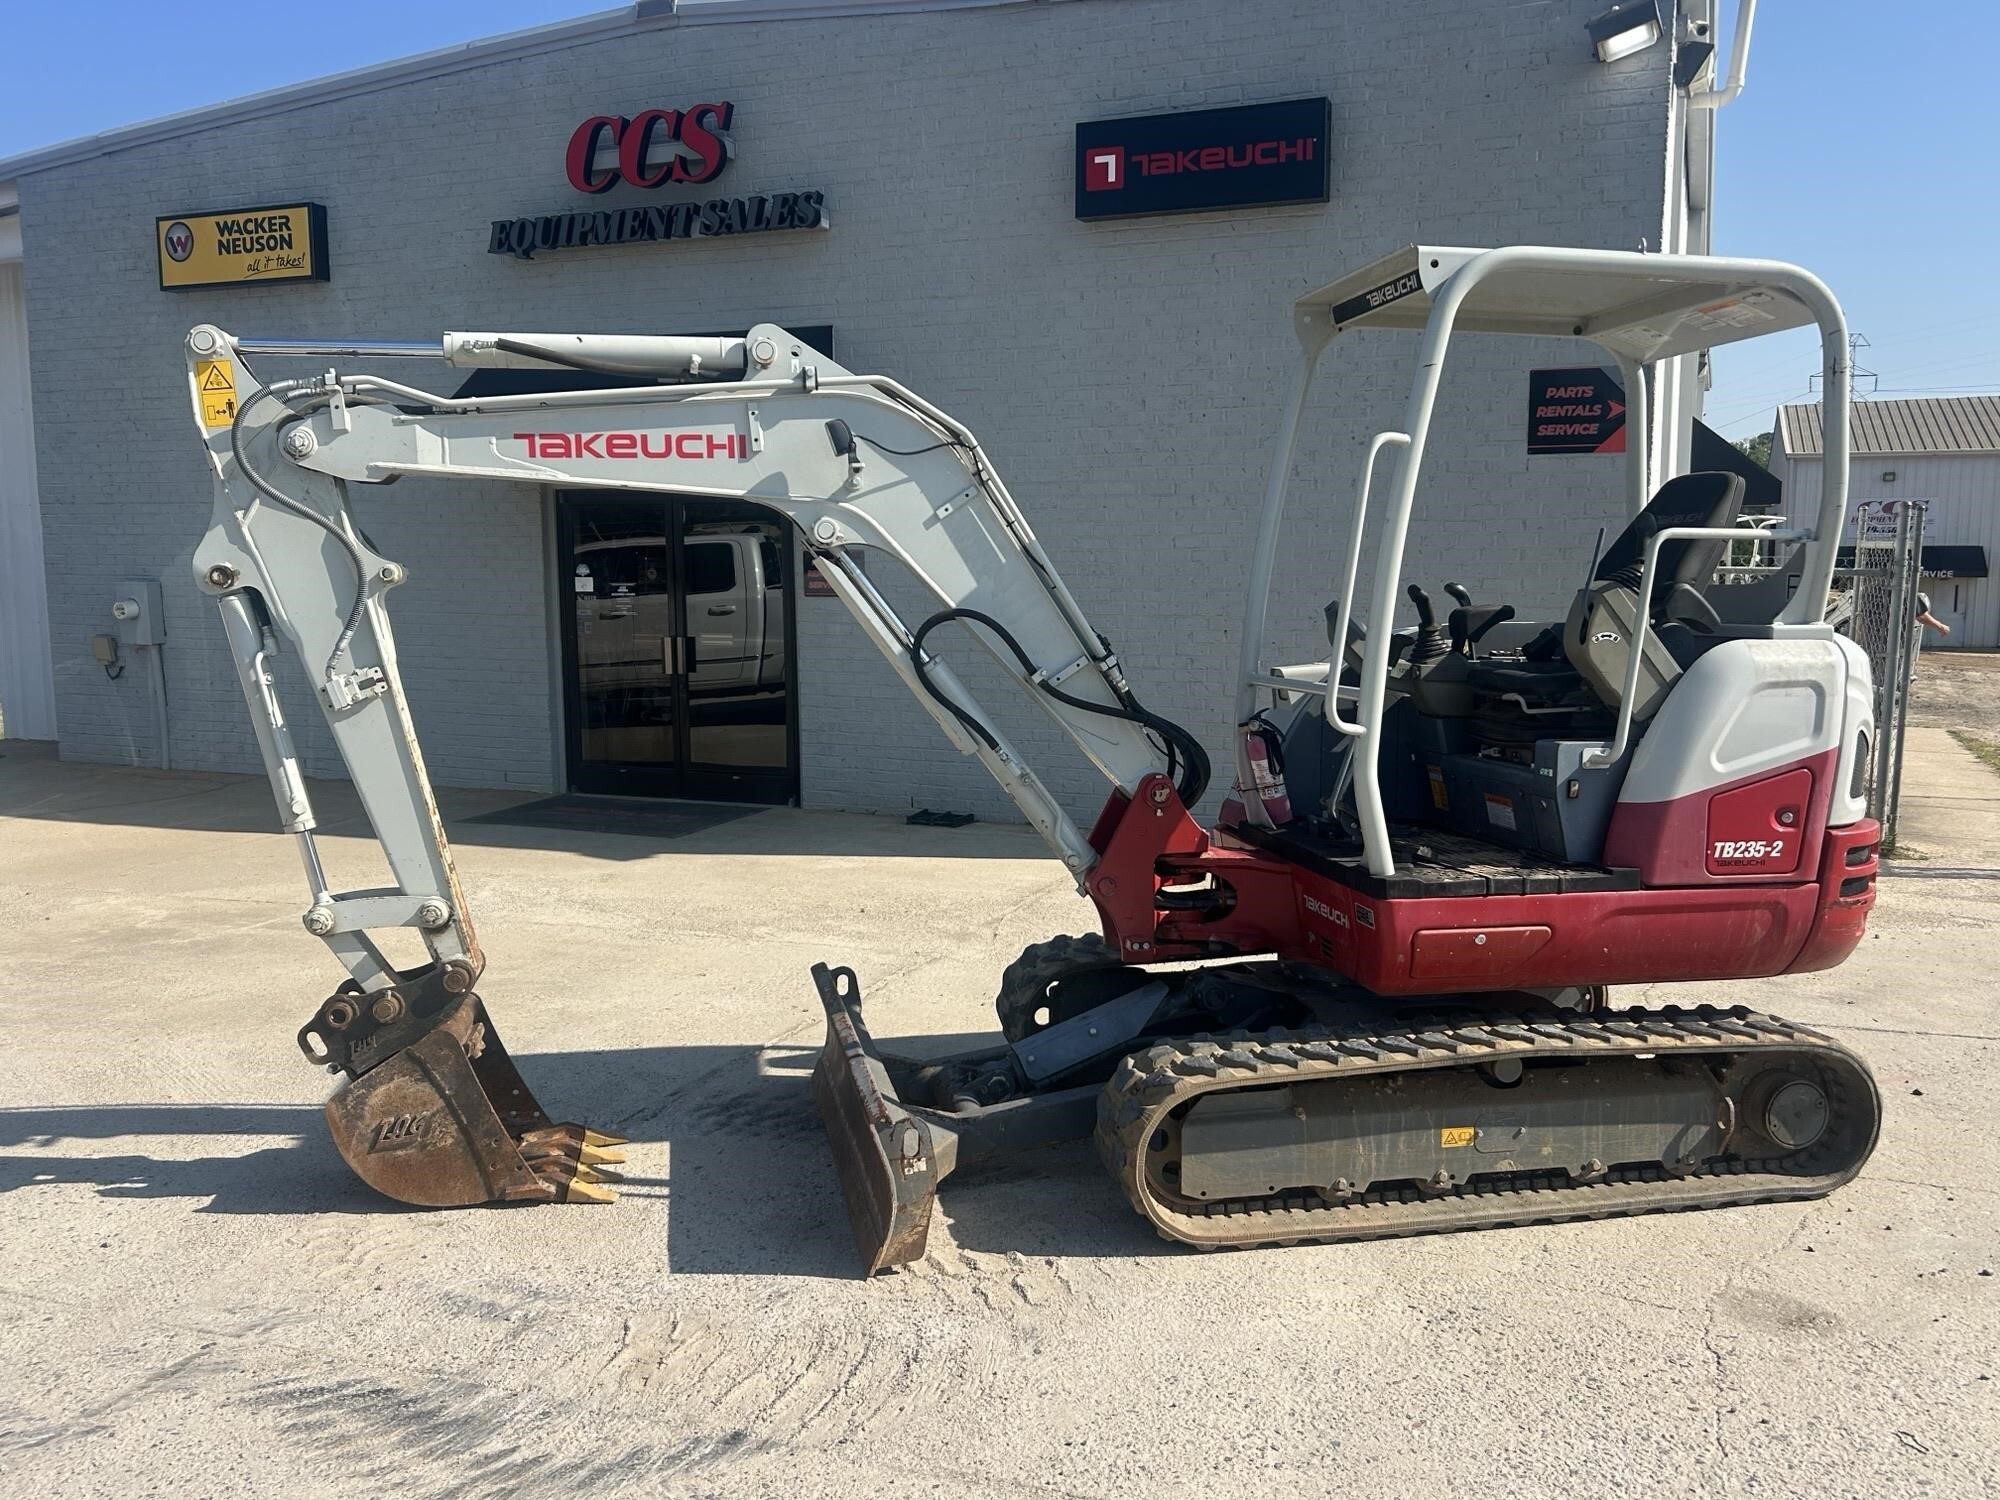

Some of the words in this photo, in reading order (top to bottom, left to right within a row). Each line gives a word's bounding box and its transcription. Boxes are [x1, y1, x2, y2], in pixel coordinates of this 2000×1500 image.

[566, 101, 733, 193] CCS
[1131, 138, 1313, 176] TAKEUCHI
[215, 215, 292, 237] WACKER
[489, 203, 700, 259] EQUIPMENT
[701, 191, 824, 236] SALES
[218, 233, 293, 256] NEUSON
[247, 258, 260, 272] all
[264, 256, 274, 270] it
[275, 252, 306, 268] takes!
[1366, 274, 1418, 307] TAKEUCHI
[1545, 385, 1595, 399] PARTS
[1536, 404, 1602, 418] RENTALS
[1537, 423, 1600, 436] SERVICE
[513, 433, 747, 459] TAKEUCHI
[1919, 570, 1954, 578] ERVICE
[1713, 840, 1784, 858] TB235-2
